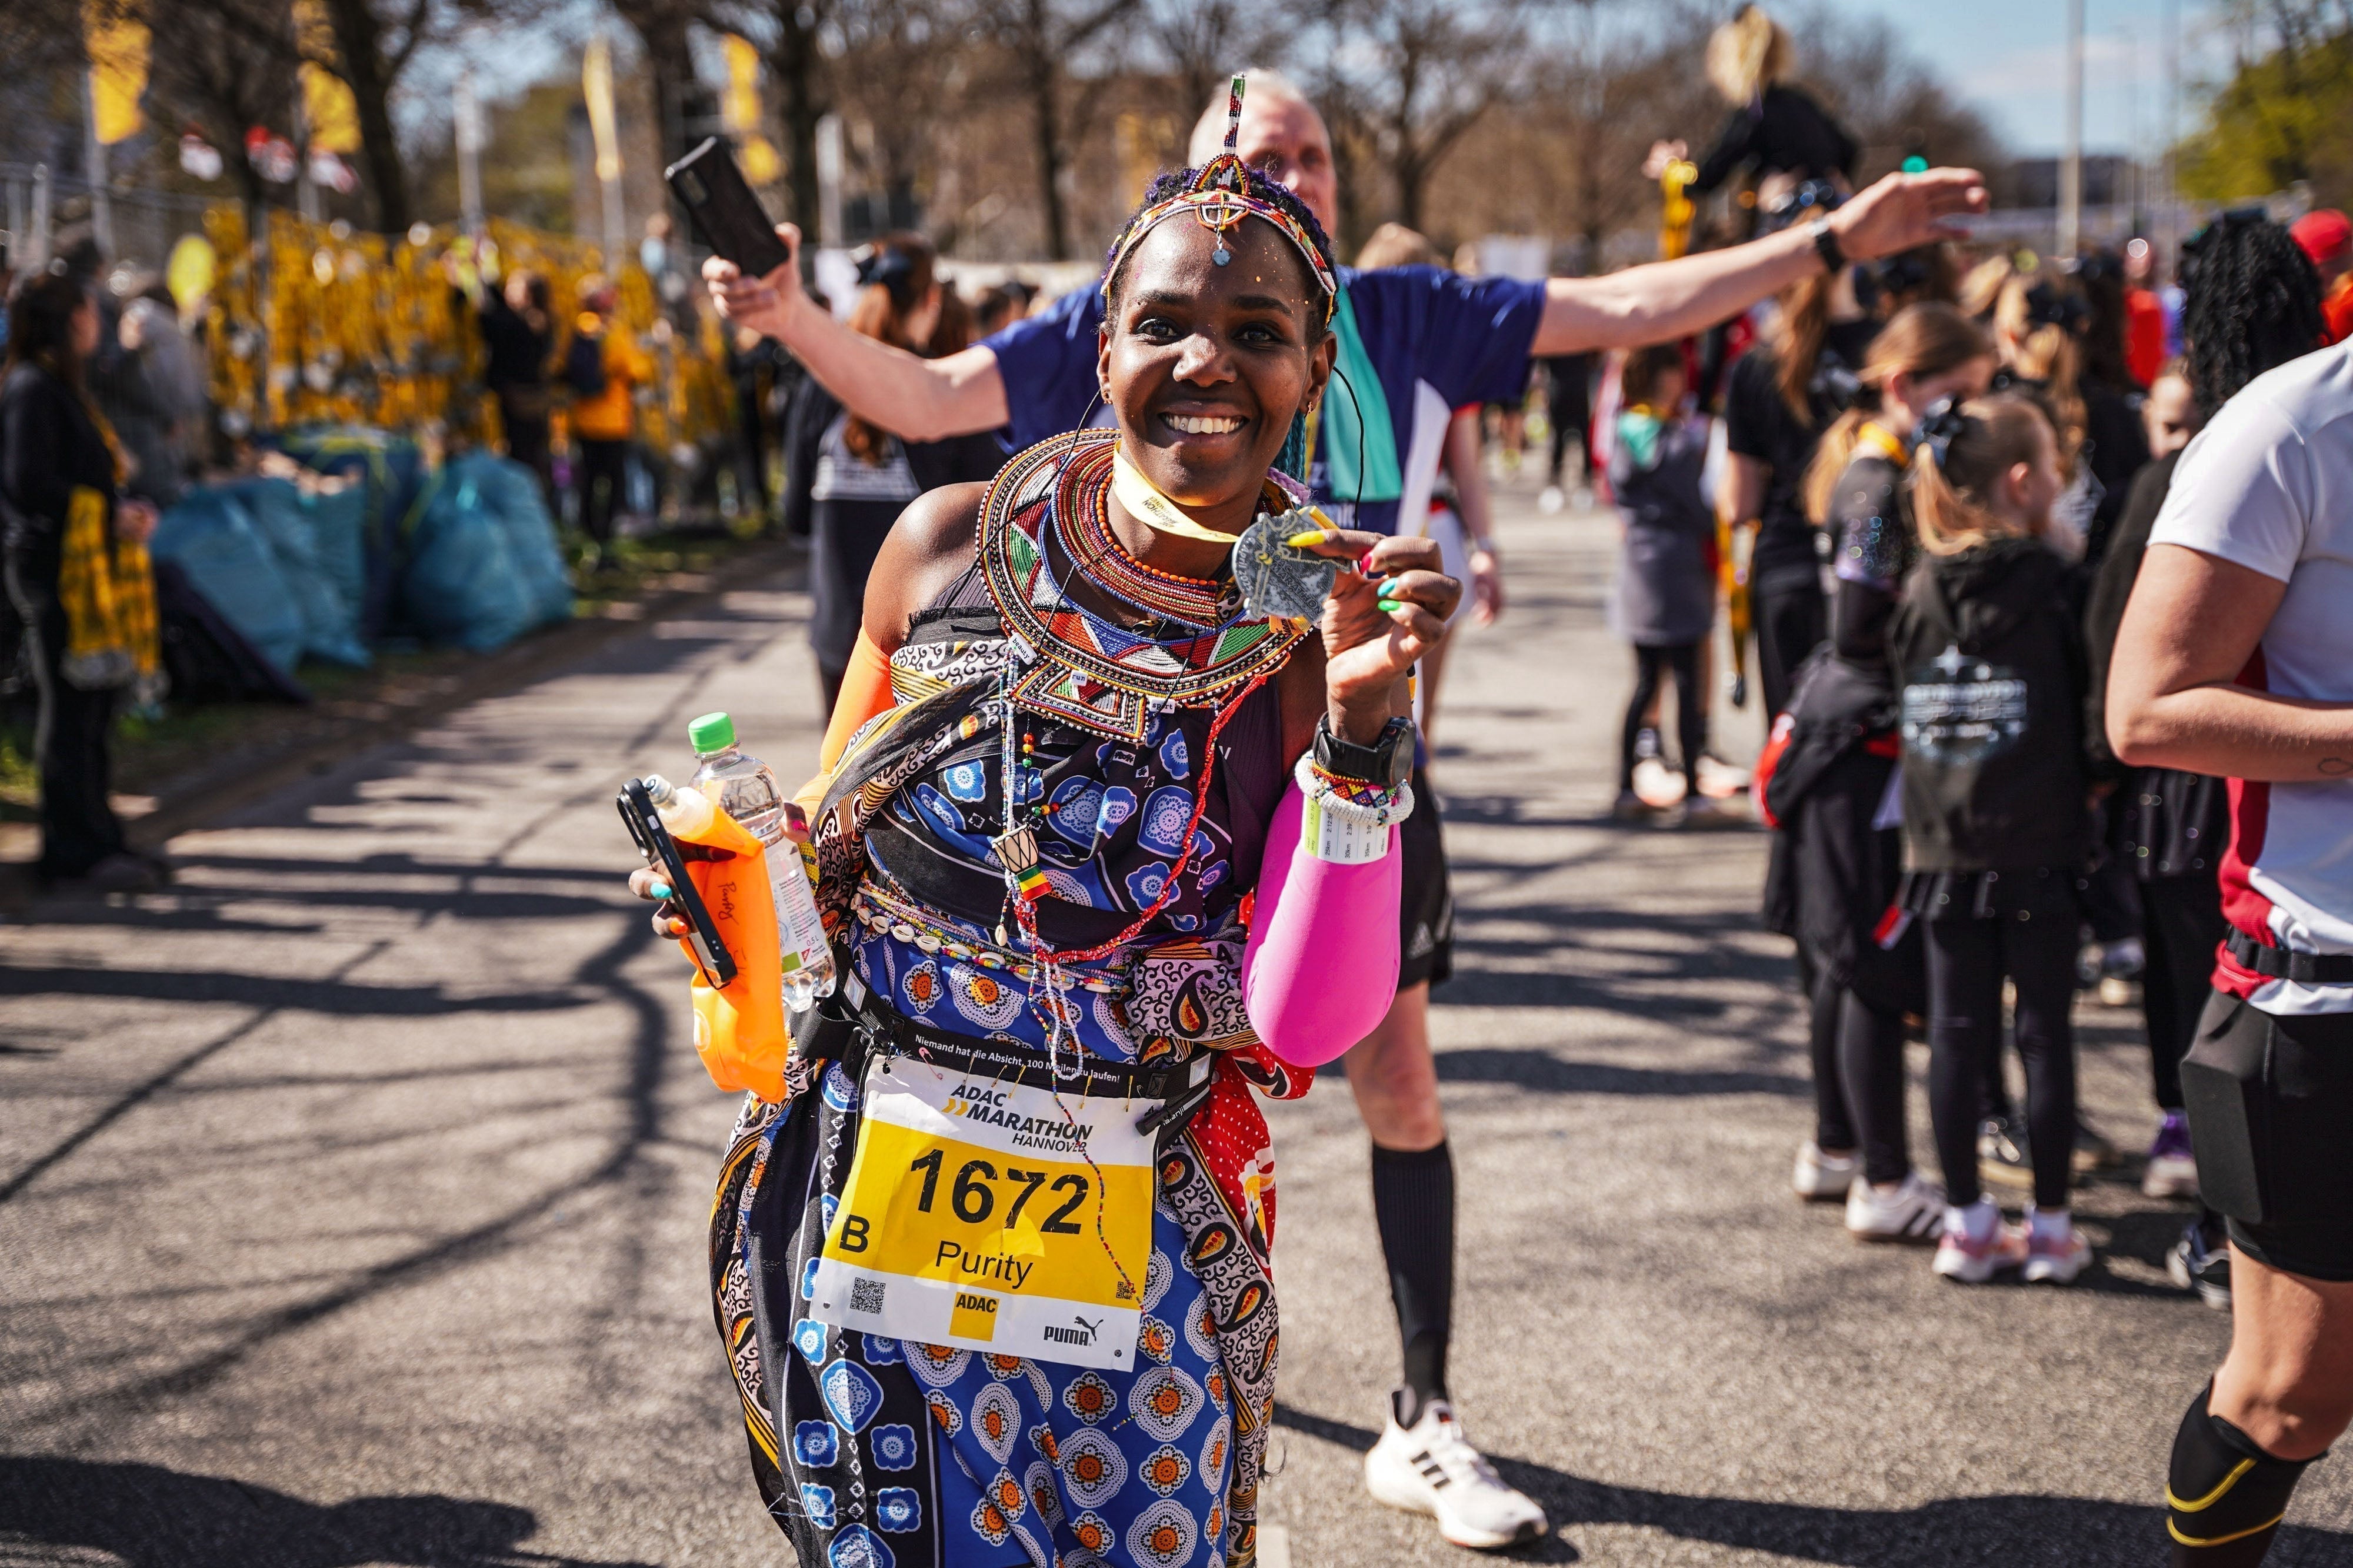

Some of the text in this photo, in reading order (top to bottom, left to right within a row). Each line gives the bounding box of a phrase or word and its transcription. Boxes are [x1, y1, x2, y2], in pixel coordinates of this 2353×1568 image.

[1238, 544, 1249, 568] April
[1239, 569, 1254, 591] 2025
[1270, 562, 1323, 616] MARATHON
[1012, 638, 1030, 659] beauty
[1152, 702, 1173, 710] sprt
[806, 937, 815, 946] 0,5
[915, 1034, 954, 1053] Niemand
[955, 1045, 971, 1057] hat
[974, 1049, 986, 1059] die
[988, 1052, 1024, 1067] Absicht,
[1027, 1059, 1044, 1069] 100
[1091, 1069, 1120, 1083] laufen!
[951, 1084, 1007, 1107] ADAC
[966, 1103, 1094, 1140] MARATHON
[1012, 1133, 1087, 1153] HANNOVER
[910, 1149, 1089, 1235] 1672
[839, 1213, 871, 1253] B
[935, 1240, 1034, 1290] Purity
[956, 1294, 997, 1313] ADAC
[1044, 1326, 1089, 1346] PUMA
